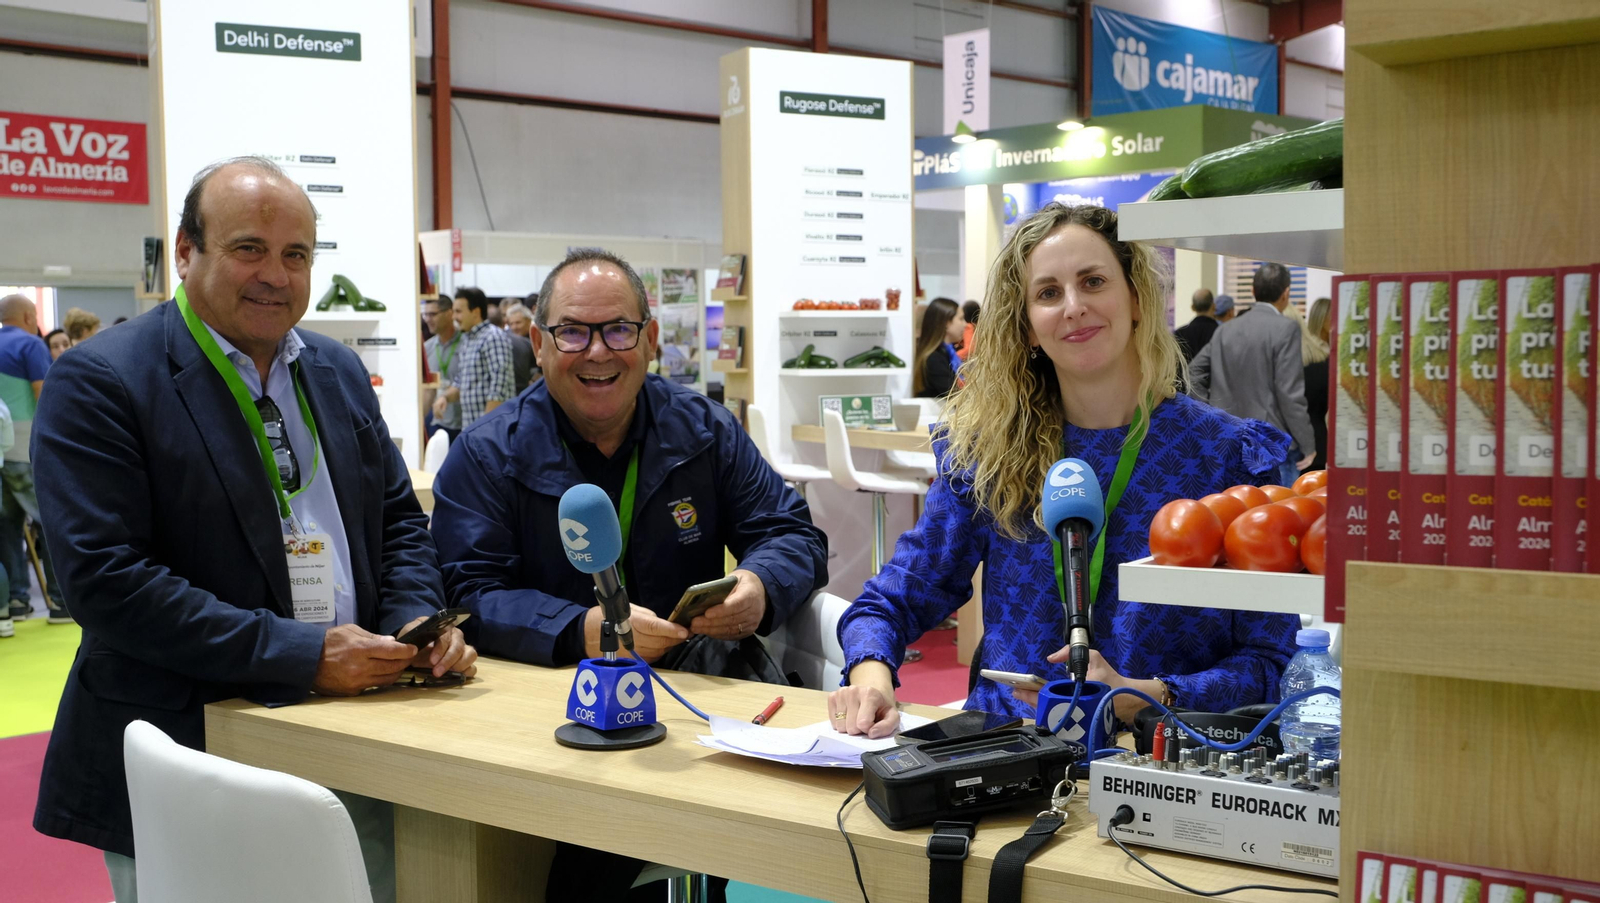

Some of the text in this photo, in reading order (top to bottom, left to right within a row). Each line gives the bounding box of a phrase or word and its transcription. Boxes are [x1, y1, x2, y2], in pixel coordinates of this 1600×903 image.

[223, 29, 269, 48] Delhi
[961, 40, 977, 115] Unicaja
[1155, 52, 1260, 104] cajamar
[784, 95, 827, 113] Rugose
[0, 117, 130, 161] La Voz
[1112, 131, 1164, 156] Solar
[0, 152, 129, 183] de Almería
[1521, 298, 1555, 318] La
[1050, 487, 1086, 501] COPE
[1518, 536, 1552, 549] 2024
[565, 548, 593, 563] OPE
[290, 576, 323, 586] RENSA
[575, 706, 596, 724] COPE
[616, 710, 645, 725] COPE
[1210, 791, 1308, 823] EURORACK
